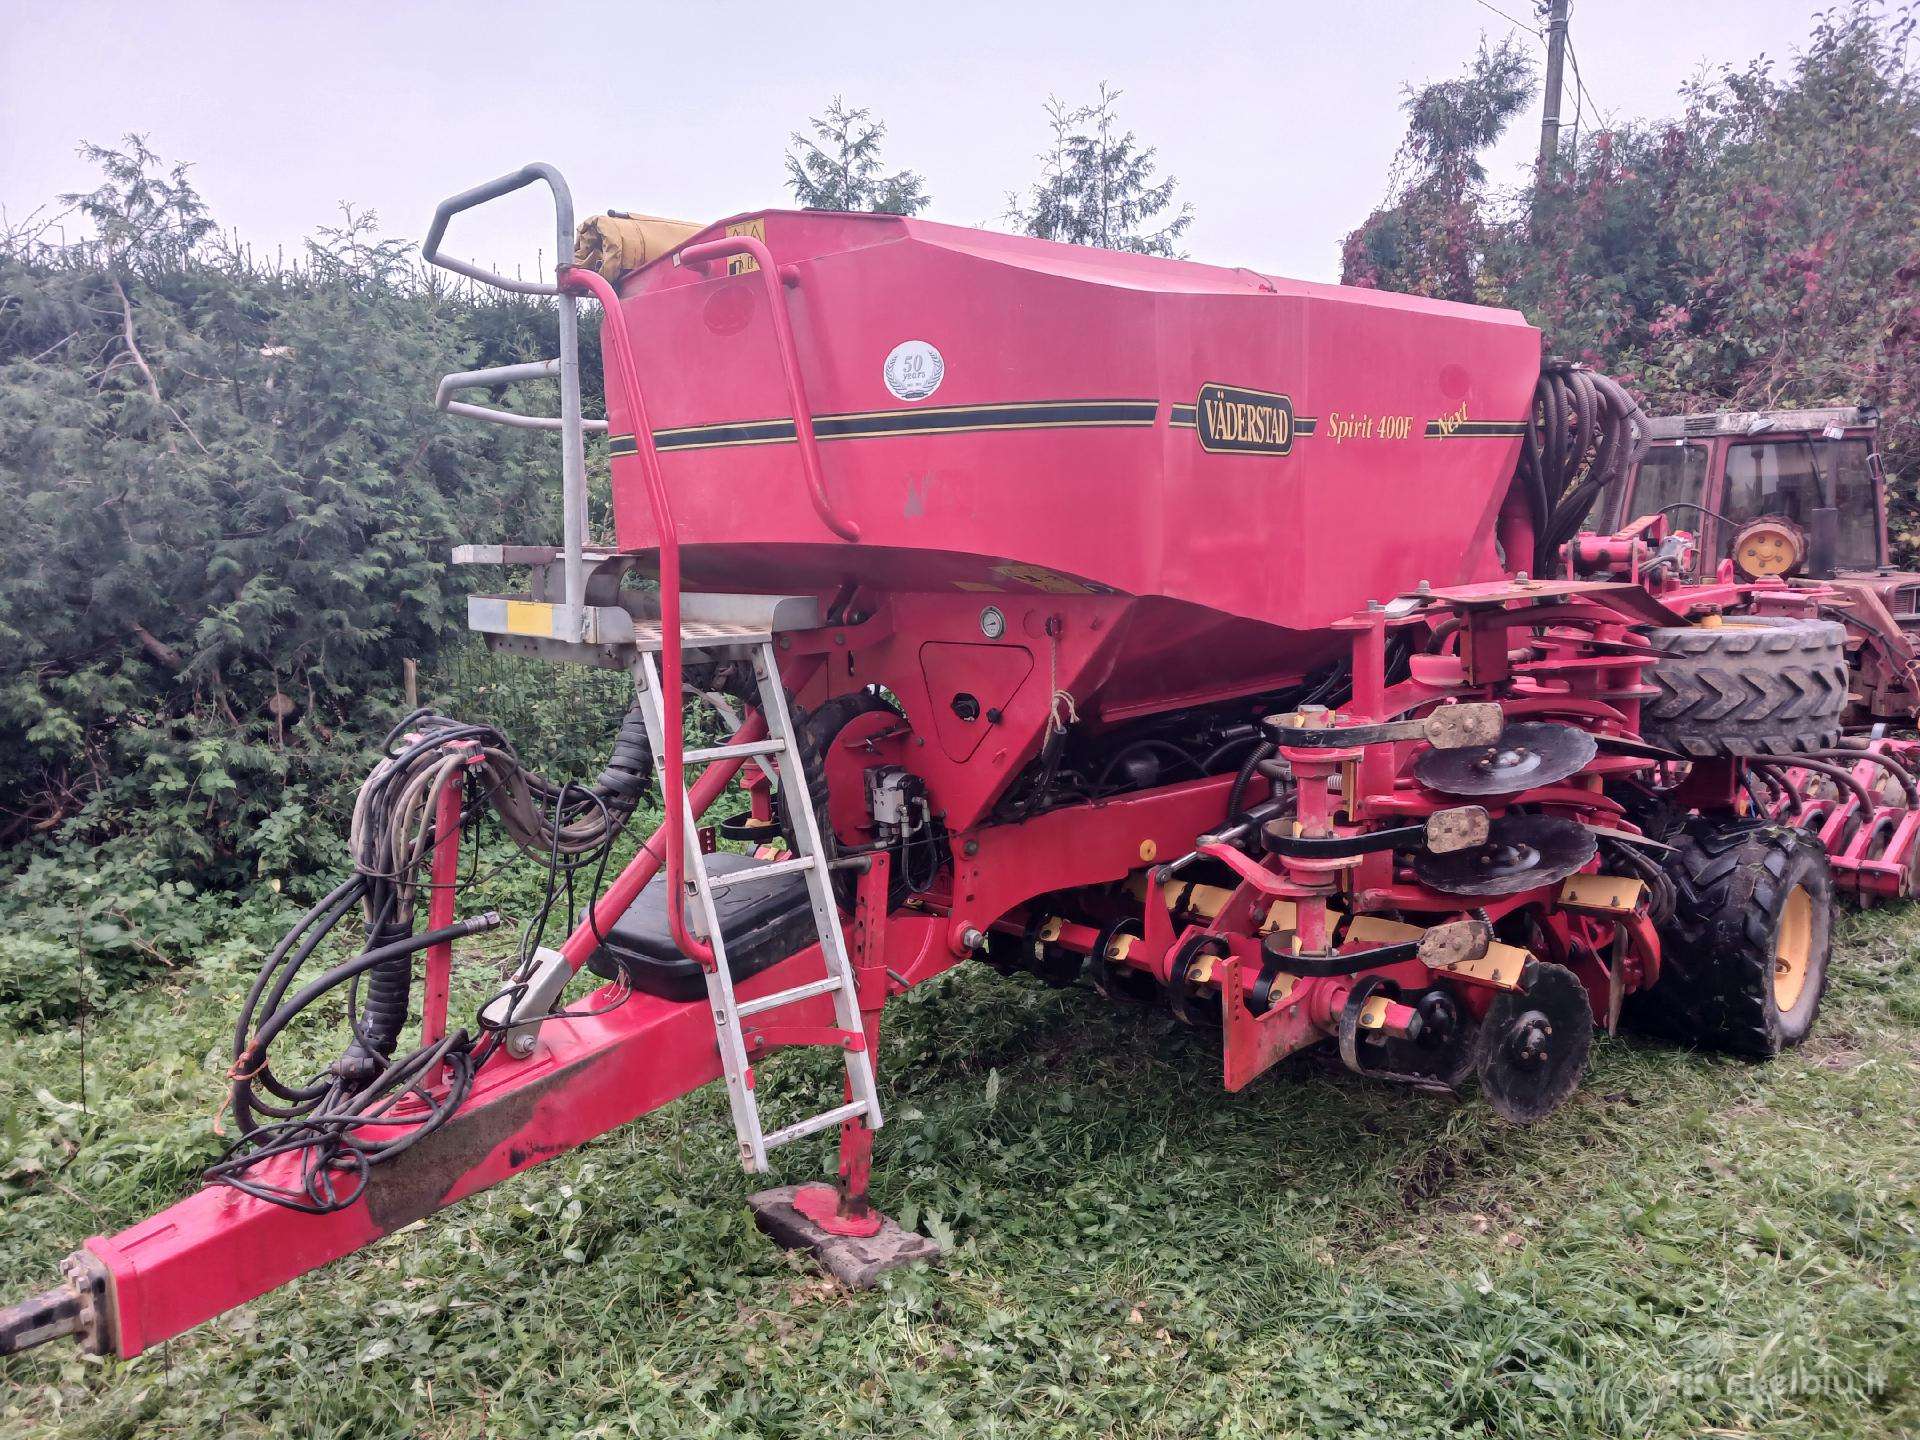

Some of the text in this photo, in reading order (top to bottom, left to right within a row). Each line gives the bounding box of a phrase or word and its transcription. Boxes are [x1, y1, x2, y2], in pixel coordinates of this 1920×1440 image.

[903, 354, 924, 372] 50
[1205, 390, 1289, 444] VÄDERSTAD
[1327, 412, 1414, 444] Spirit 400F
[1438, 401, 1469, 441] Next
